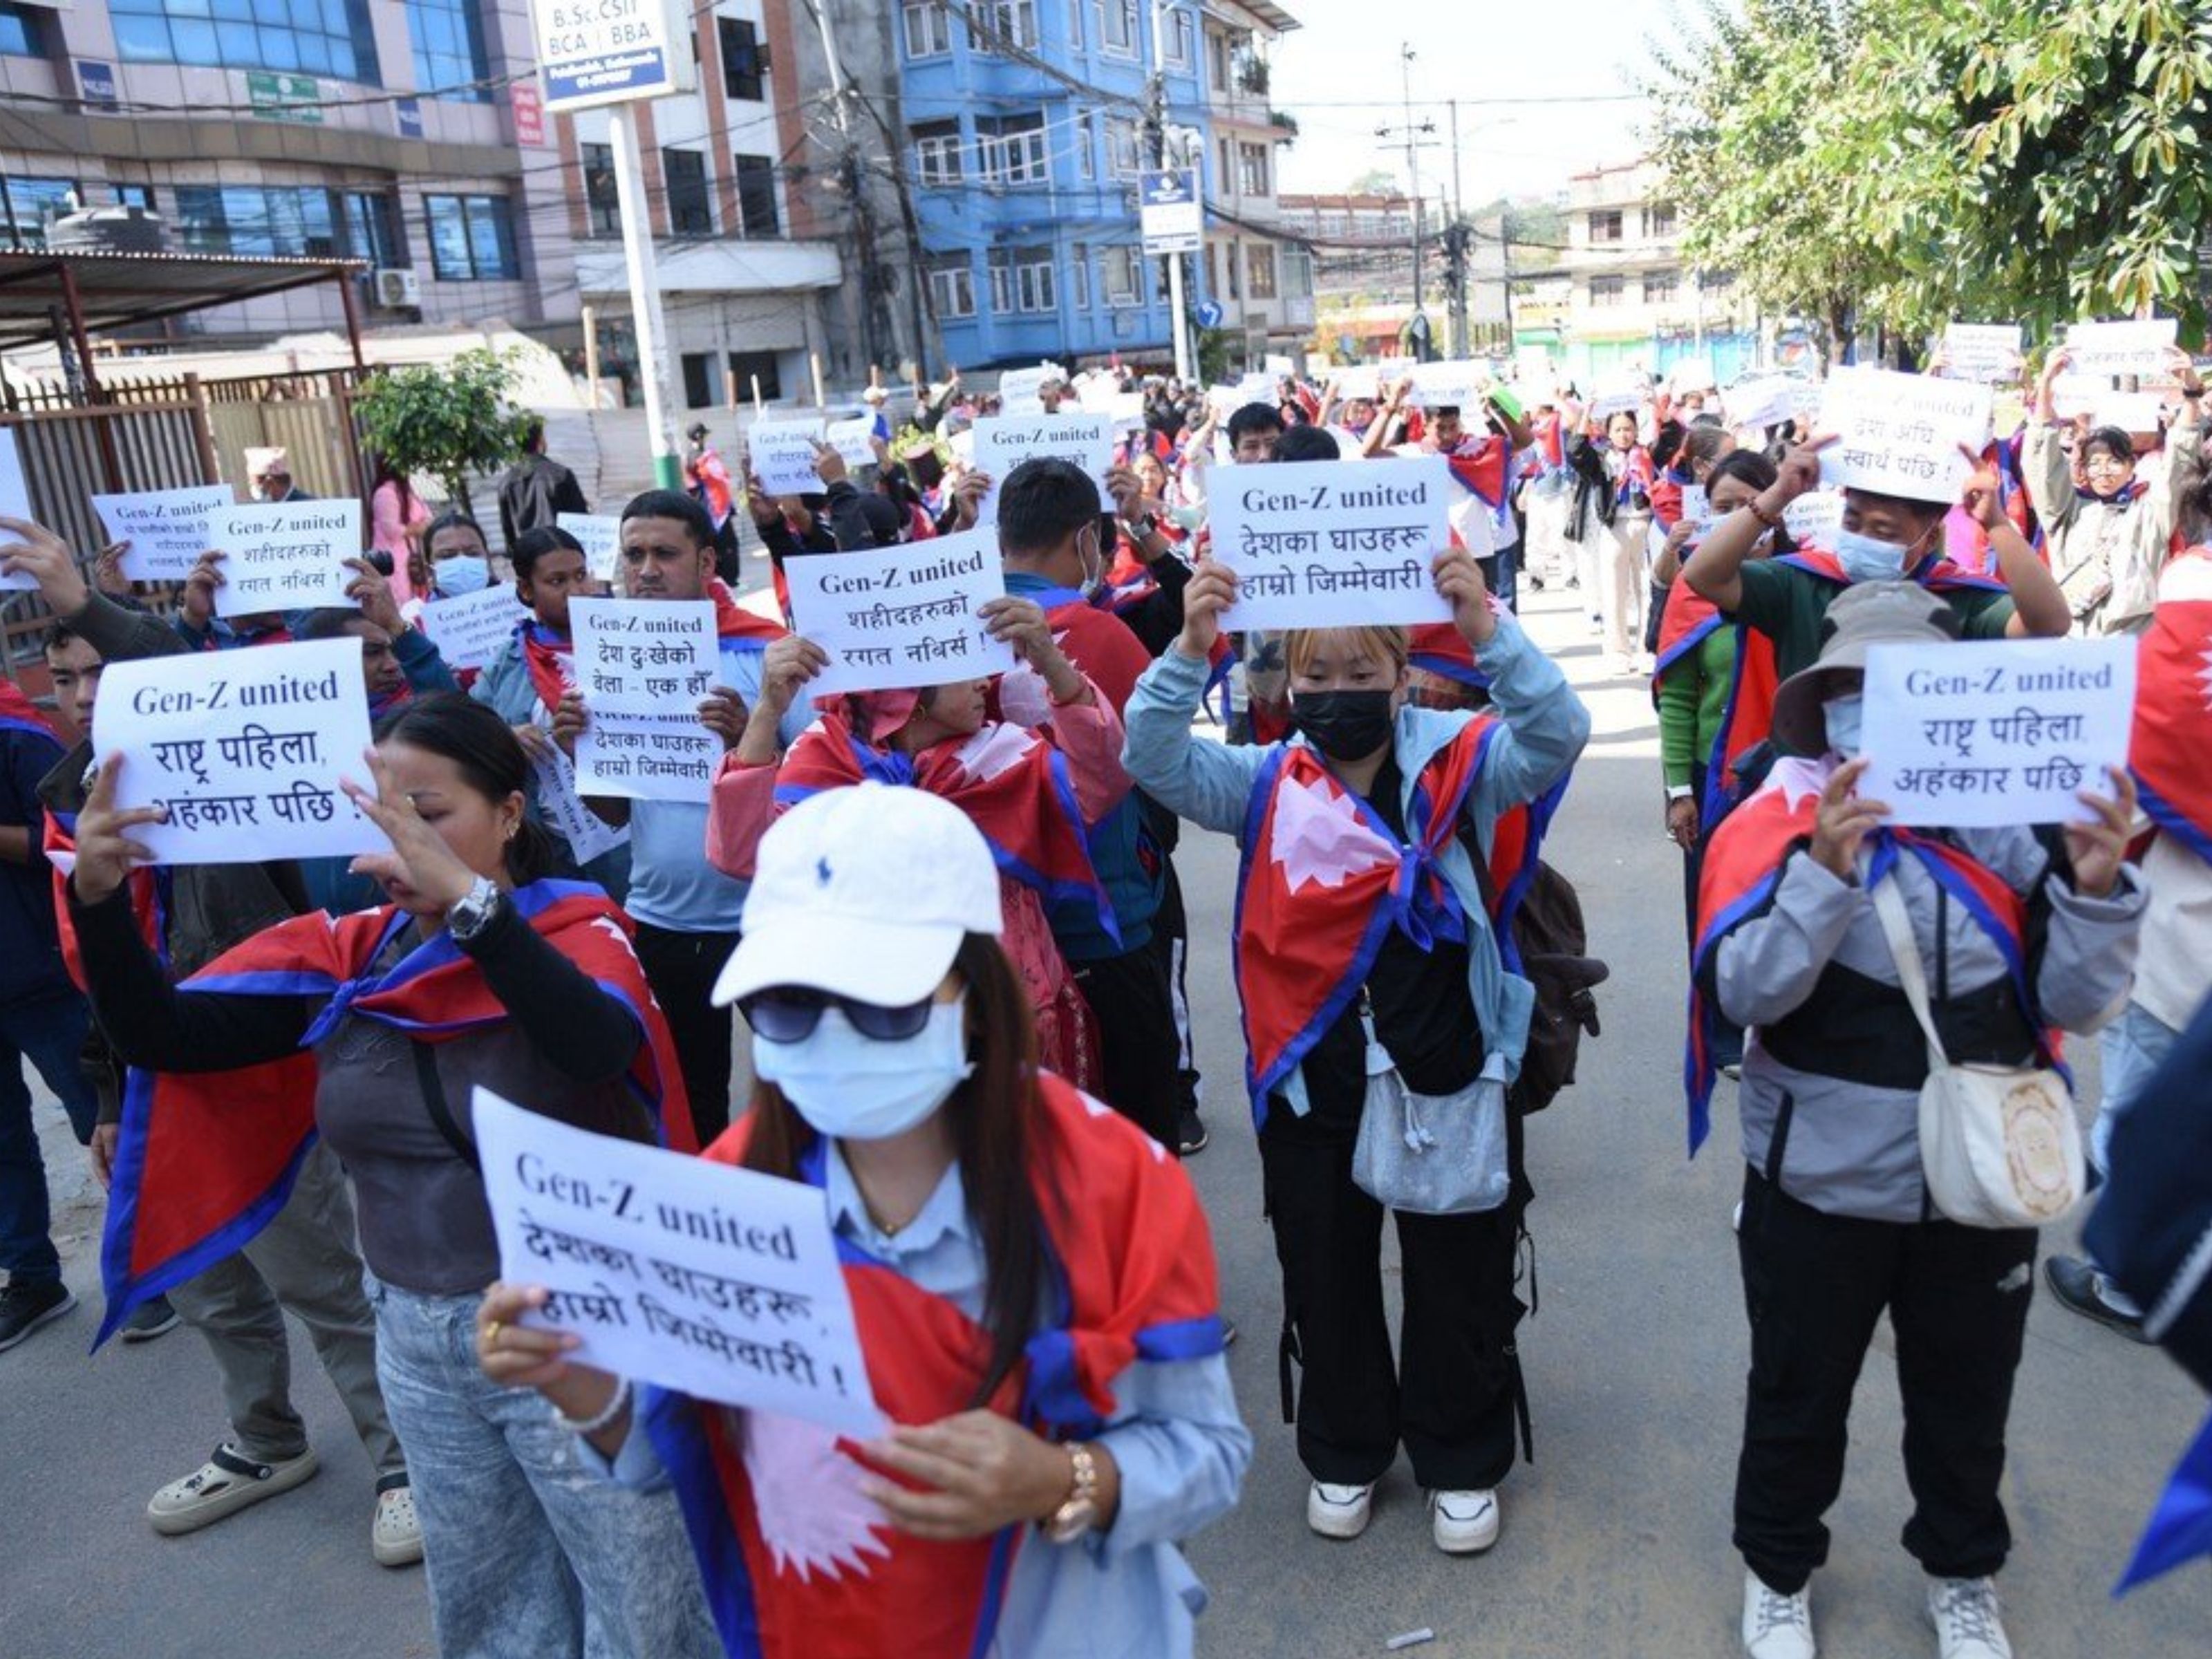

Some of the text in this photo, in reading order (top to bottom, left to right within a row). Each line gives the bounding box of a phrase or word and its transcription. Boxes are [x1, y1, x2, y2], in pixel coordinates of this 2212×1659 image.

[550, 34, 587, 55] BCA
[612, 22, 651, 44] BBA
[992, 426, 1100, 446] Gen-Z united
[1897, 453, 1938, 479] पछि
[1241, 482, 1427, 513] Gen-Z united
[227, 516, 285, 536] Gen-Z
[290, 514, 346, 533] united
[1239, 524, 1318, 558] देशका
[819, 550, 984, 594] Gen-Z united
[1239, 559, 1422, 599] हाम्रो जिम्मेवारी
[589, 614, 702, 632] Gen-Z united
[599, 637, 624, 664] देश
[841, 647, 893, 668] रगत
[132, 671, 339, 717] Gen-Z united
[645, 677, 679, 698] एक
[1906, 663, 2112, 697] Gen-Z united
[1922, 718, 1976, 757] राष्ट्र
[151, 738, 210, 785] राष्ट्र
[637, 753, 710, 780] जिम्मेवारी
[1893, 760, 2011, 796] अहंकार
[2024, 754, 2086, 791] पछि
[152, 789, 259, 831] अहंकार
[268, 780, 335, 825] पछि
[515, 1150, 799, 1262] Gen-Z united
[519, 1206, 643, 1280] देशका
[539, 1280, 630, 1327] हाम्रो
[636, 1292, 818, 1387] जिम्मेवारी
